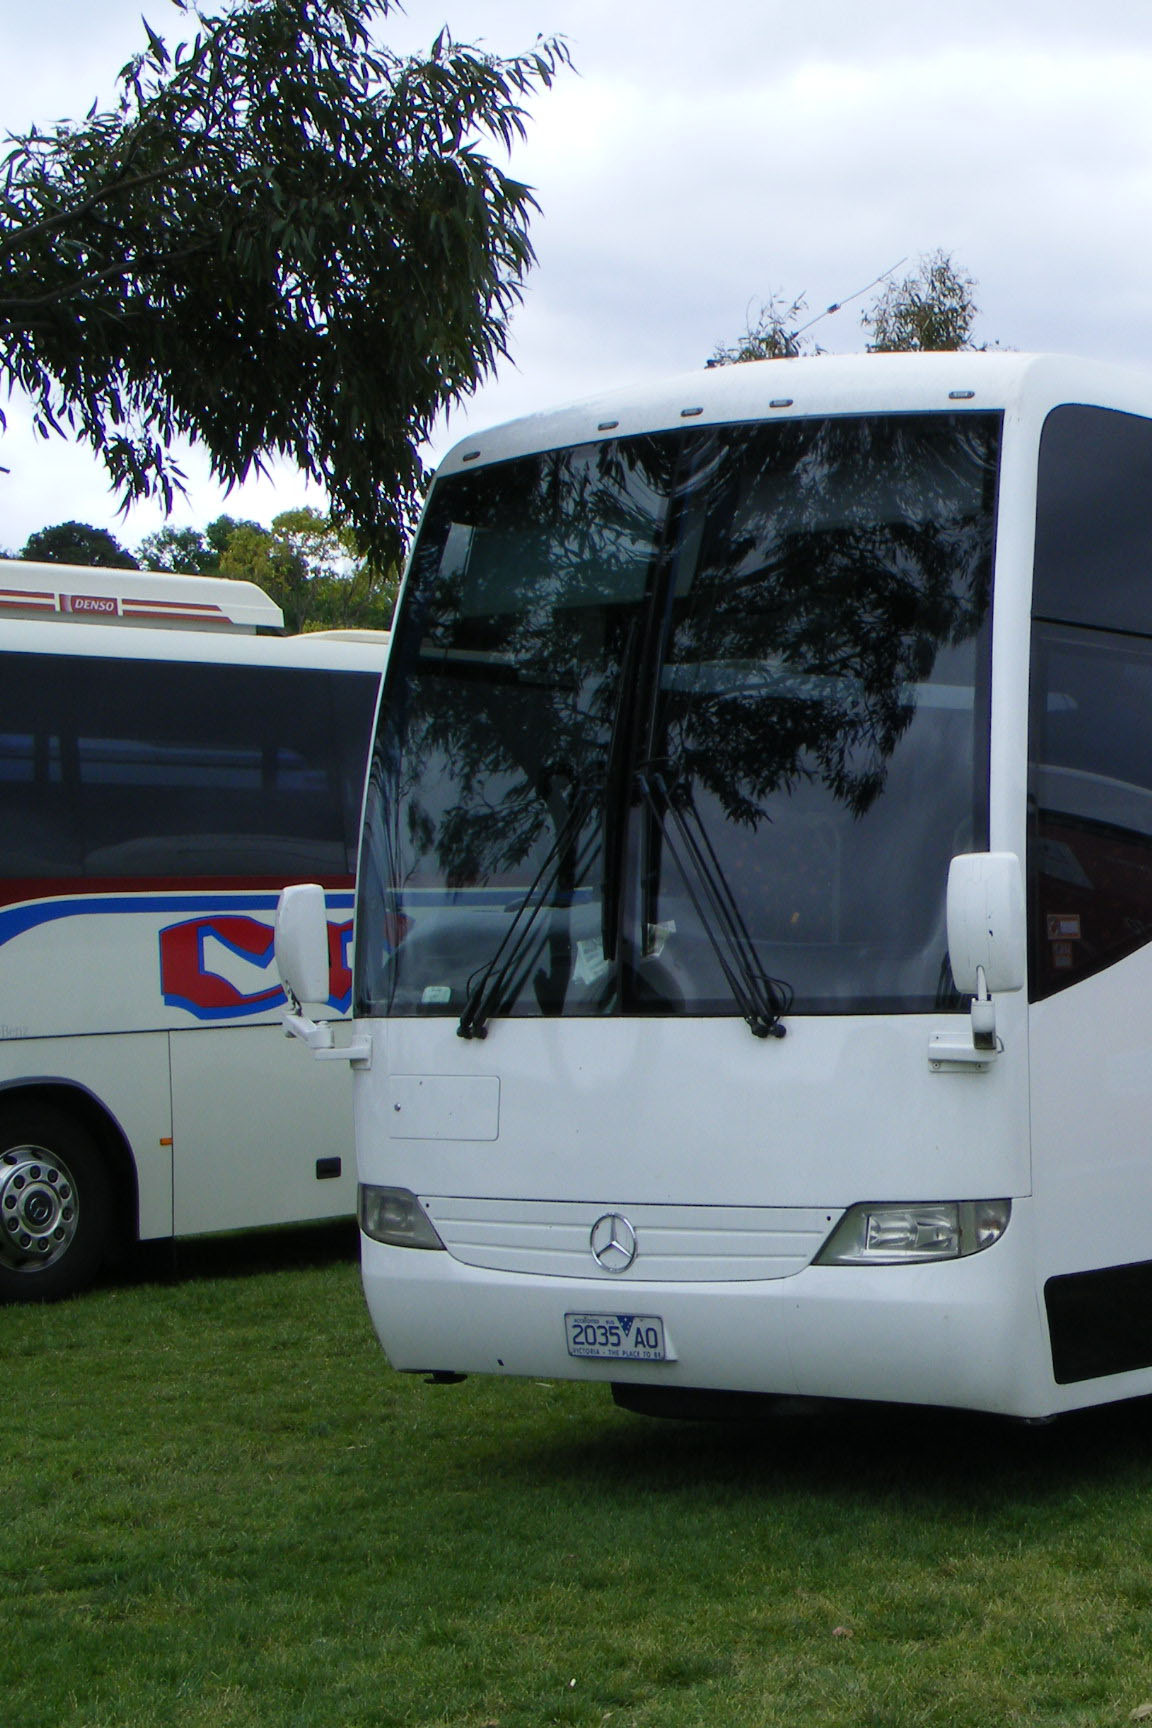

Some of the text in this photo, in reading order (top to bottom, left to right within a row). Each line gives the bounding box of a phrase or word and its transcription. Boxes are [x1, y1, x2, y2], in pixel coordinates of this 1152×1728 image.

[75, 599, 114, 611] DENSO
[572, 1324, 621, 1347] 2035
[572, 1348, 600, 1356] VICTORIA
[608, 1349, 620, 1357] THE
[622, 1350, 640, 1358] PLACE
